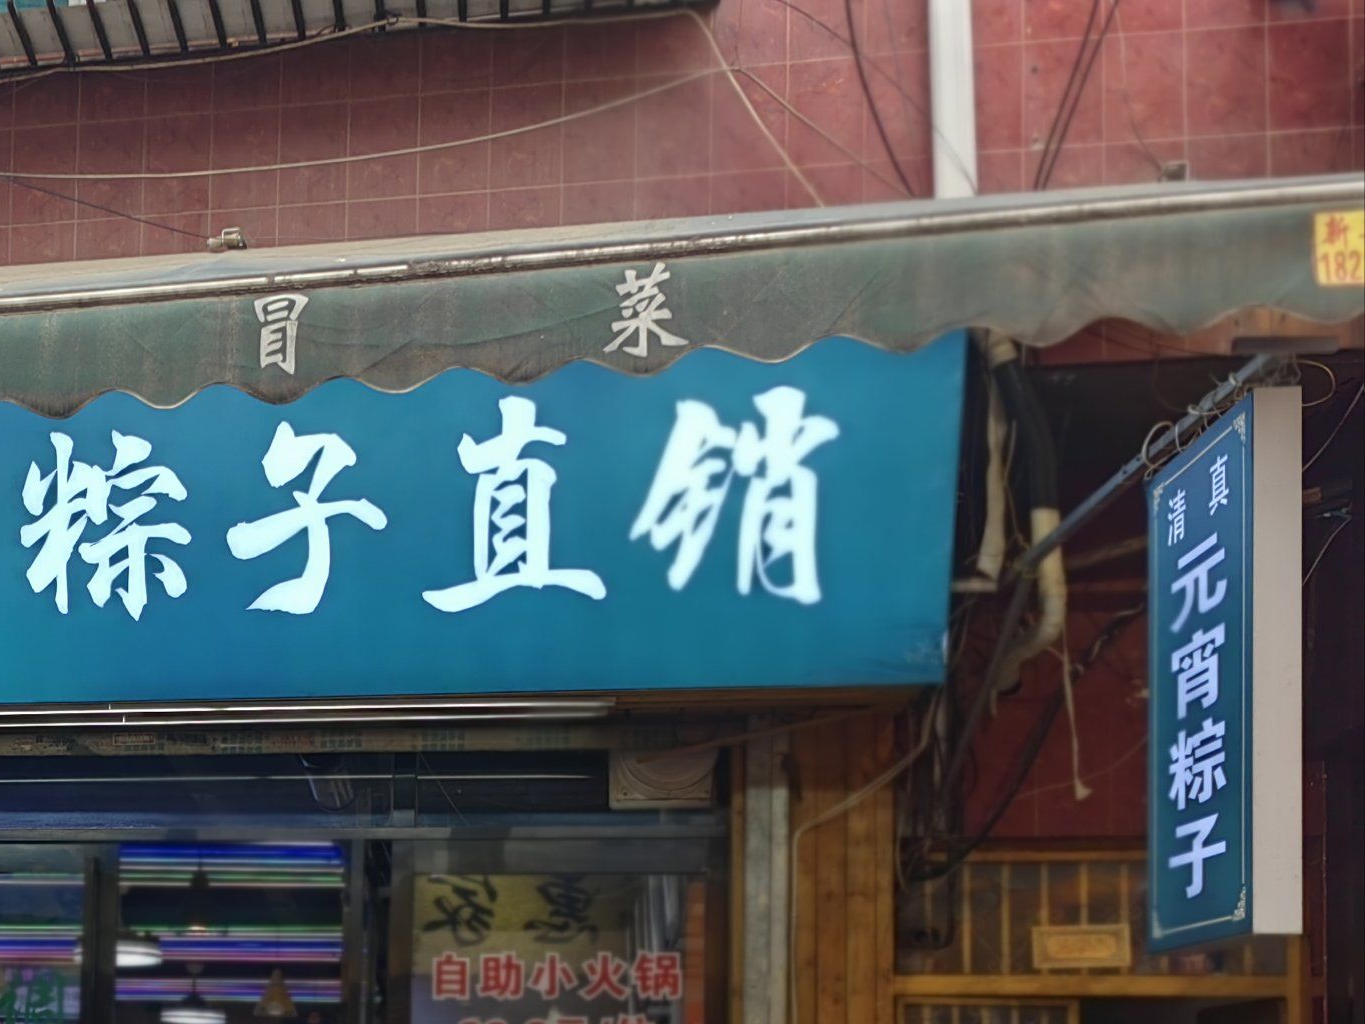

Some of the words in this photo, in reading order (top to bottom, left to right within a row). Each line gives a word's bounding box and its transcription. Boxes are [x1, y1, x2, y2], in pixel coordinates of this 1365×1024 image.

[1167, 453, 1228, 546] 清真
[1168, 532, 1228, 899] 元宵粽子
[433, 951, 683, 999] 自助小火锅
